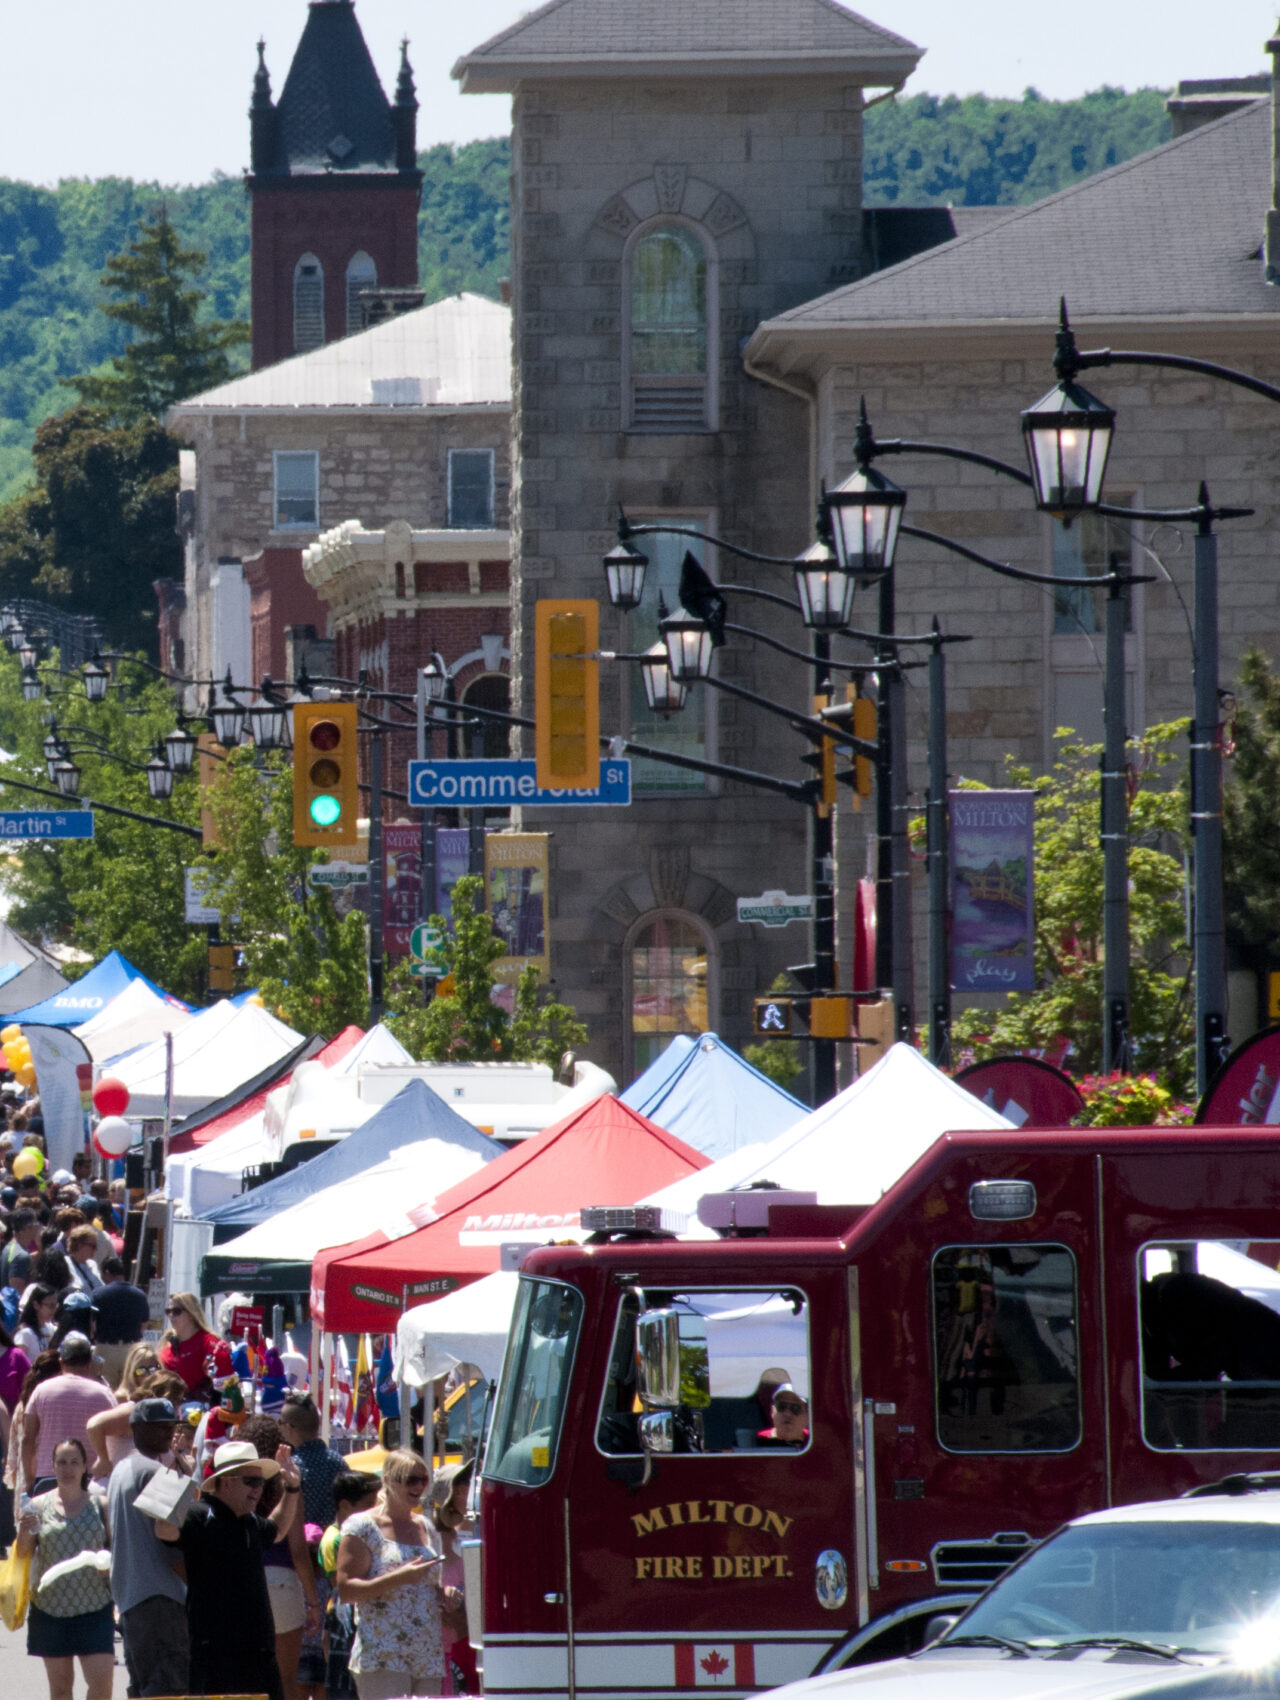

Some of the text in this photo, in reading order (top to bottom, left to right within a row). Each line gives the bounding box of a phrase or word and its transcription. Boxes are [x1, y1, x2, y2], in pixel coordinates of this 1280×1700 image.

[606, 768, 624, 784] St
[55, 816, 67, 827] St
[953, 811, 1027, 827] MILTON
[489, 849, 543, 861] MILTON
[740, 905, 795, 918] COMMERCIAL
[966, 958, 1017, 983] play
[53, 996, 104, 1009] BMO
[462, 1212, 582, 1232] Milton
[354, 1286, 385, 1302] ONTARIO
[413, 1282, 430, 1295] MAIN
[630, 1500, 794, 1537] MILTON
[635, 1555, 794, 1579] FIRE DEPT.
